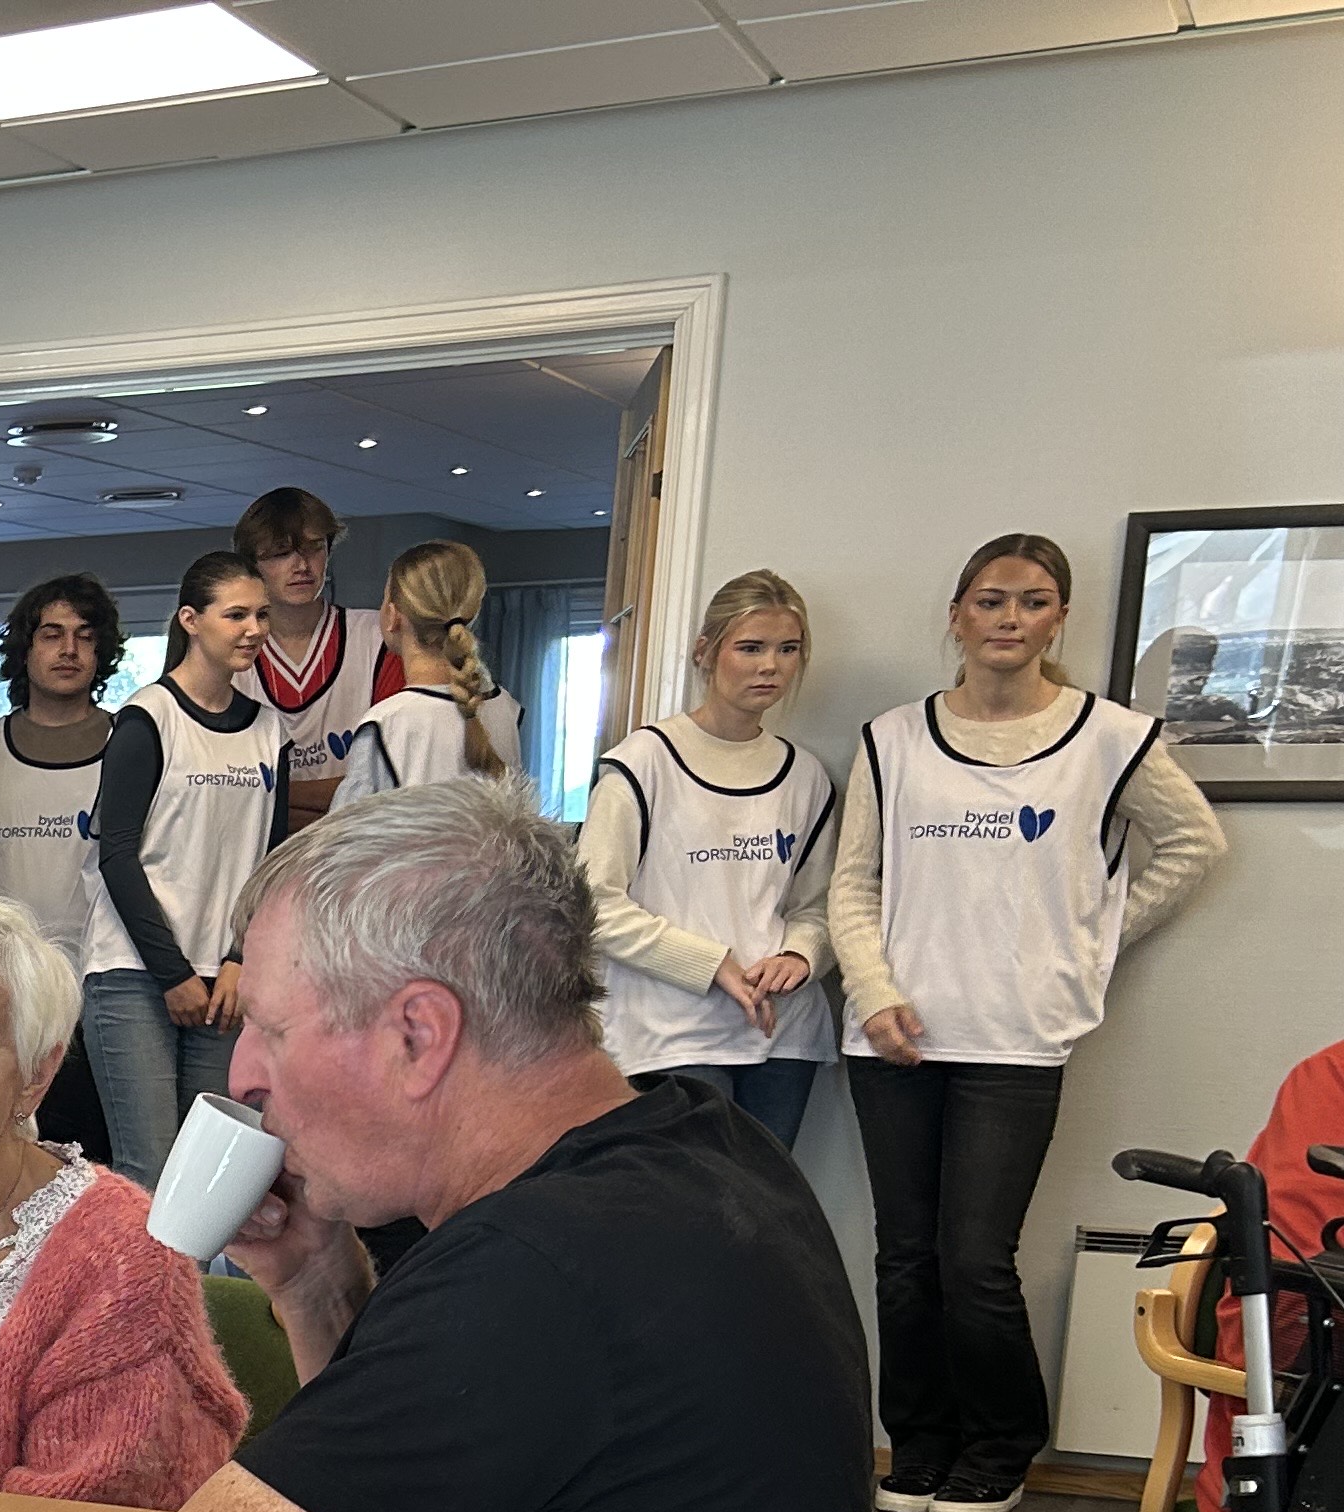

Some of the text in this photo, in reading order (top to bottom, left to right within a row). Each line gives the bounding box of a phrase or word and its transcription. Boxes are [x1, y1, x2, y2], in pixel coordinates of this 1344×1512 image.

[227, 764, 259, 776] bydel
[186, 774, 262, 788] TORSTRAND
[38, 814, 75, 828] bydel
[965, 810, 1015, 826] bydel
[733, 834, 773, 849] bydel
[686, 848, 773, 864] TORSTRAND
